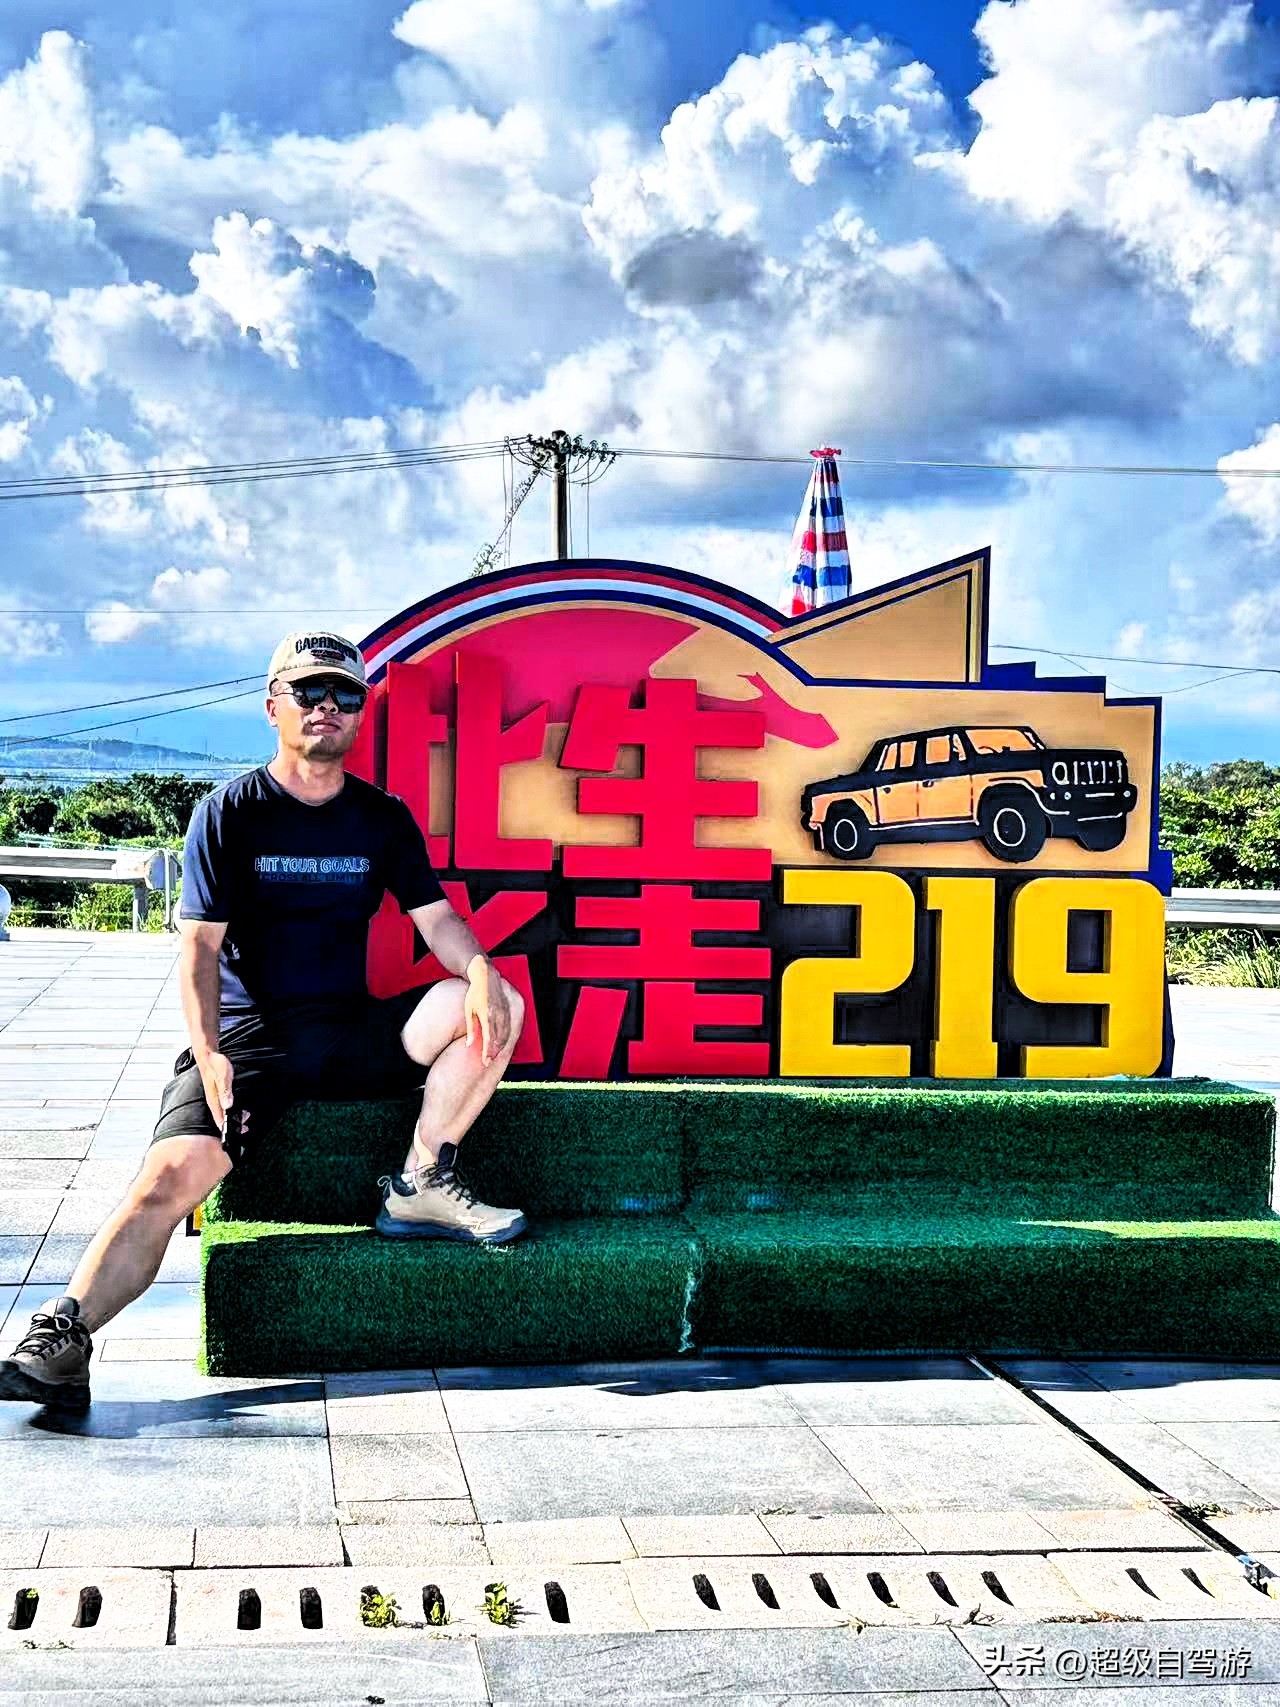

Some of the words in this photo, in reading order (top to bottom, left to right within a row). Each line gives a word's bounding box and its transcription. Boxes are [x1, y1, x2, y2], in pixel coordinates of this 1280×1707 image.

[255, 857, 279, 873] HIT
[281, 857, 317, 873] YOUR
[320, 858, 370, 873] GOALS
[779, 868, 1165, 1079] 219
